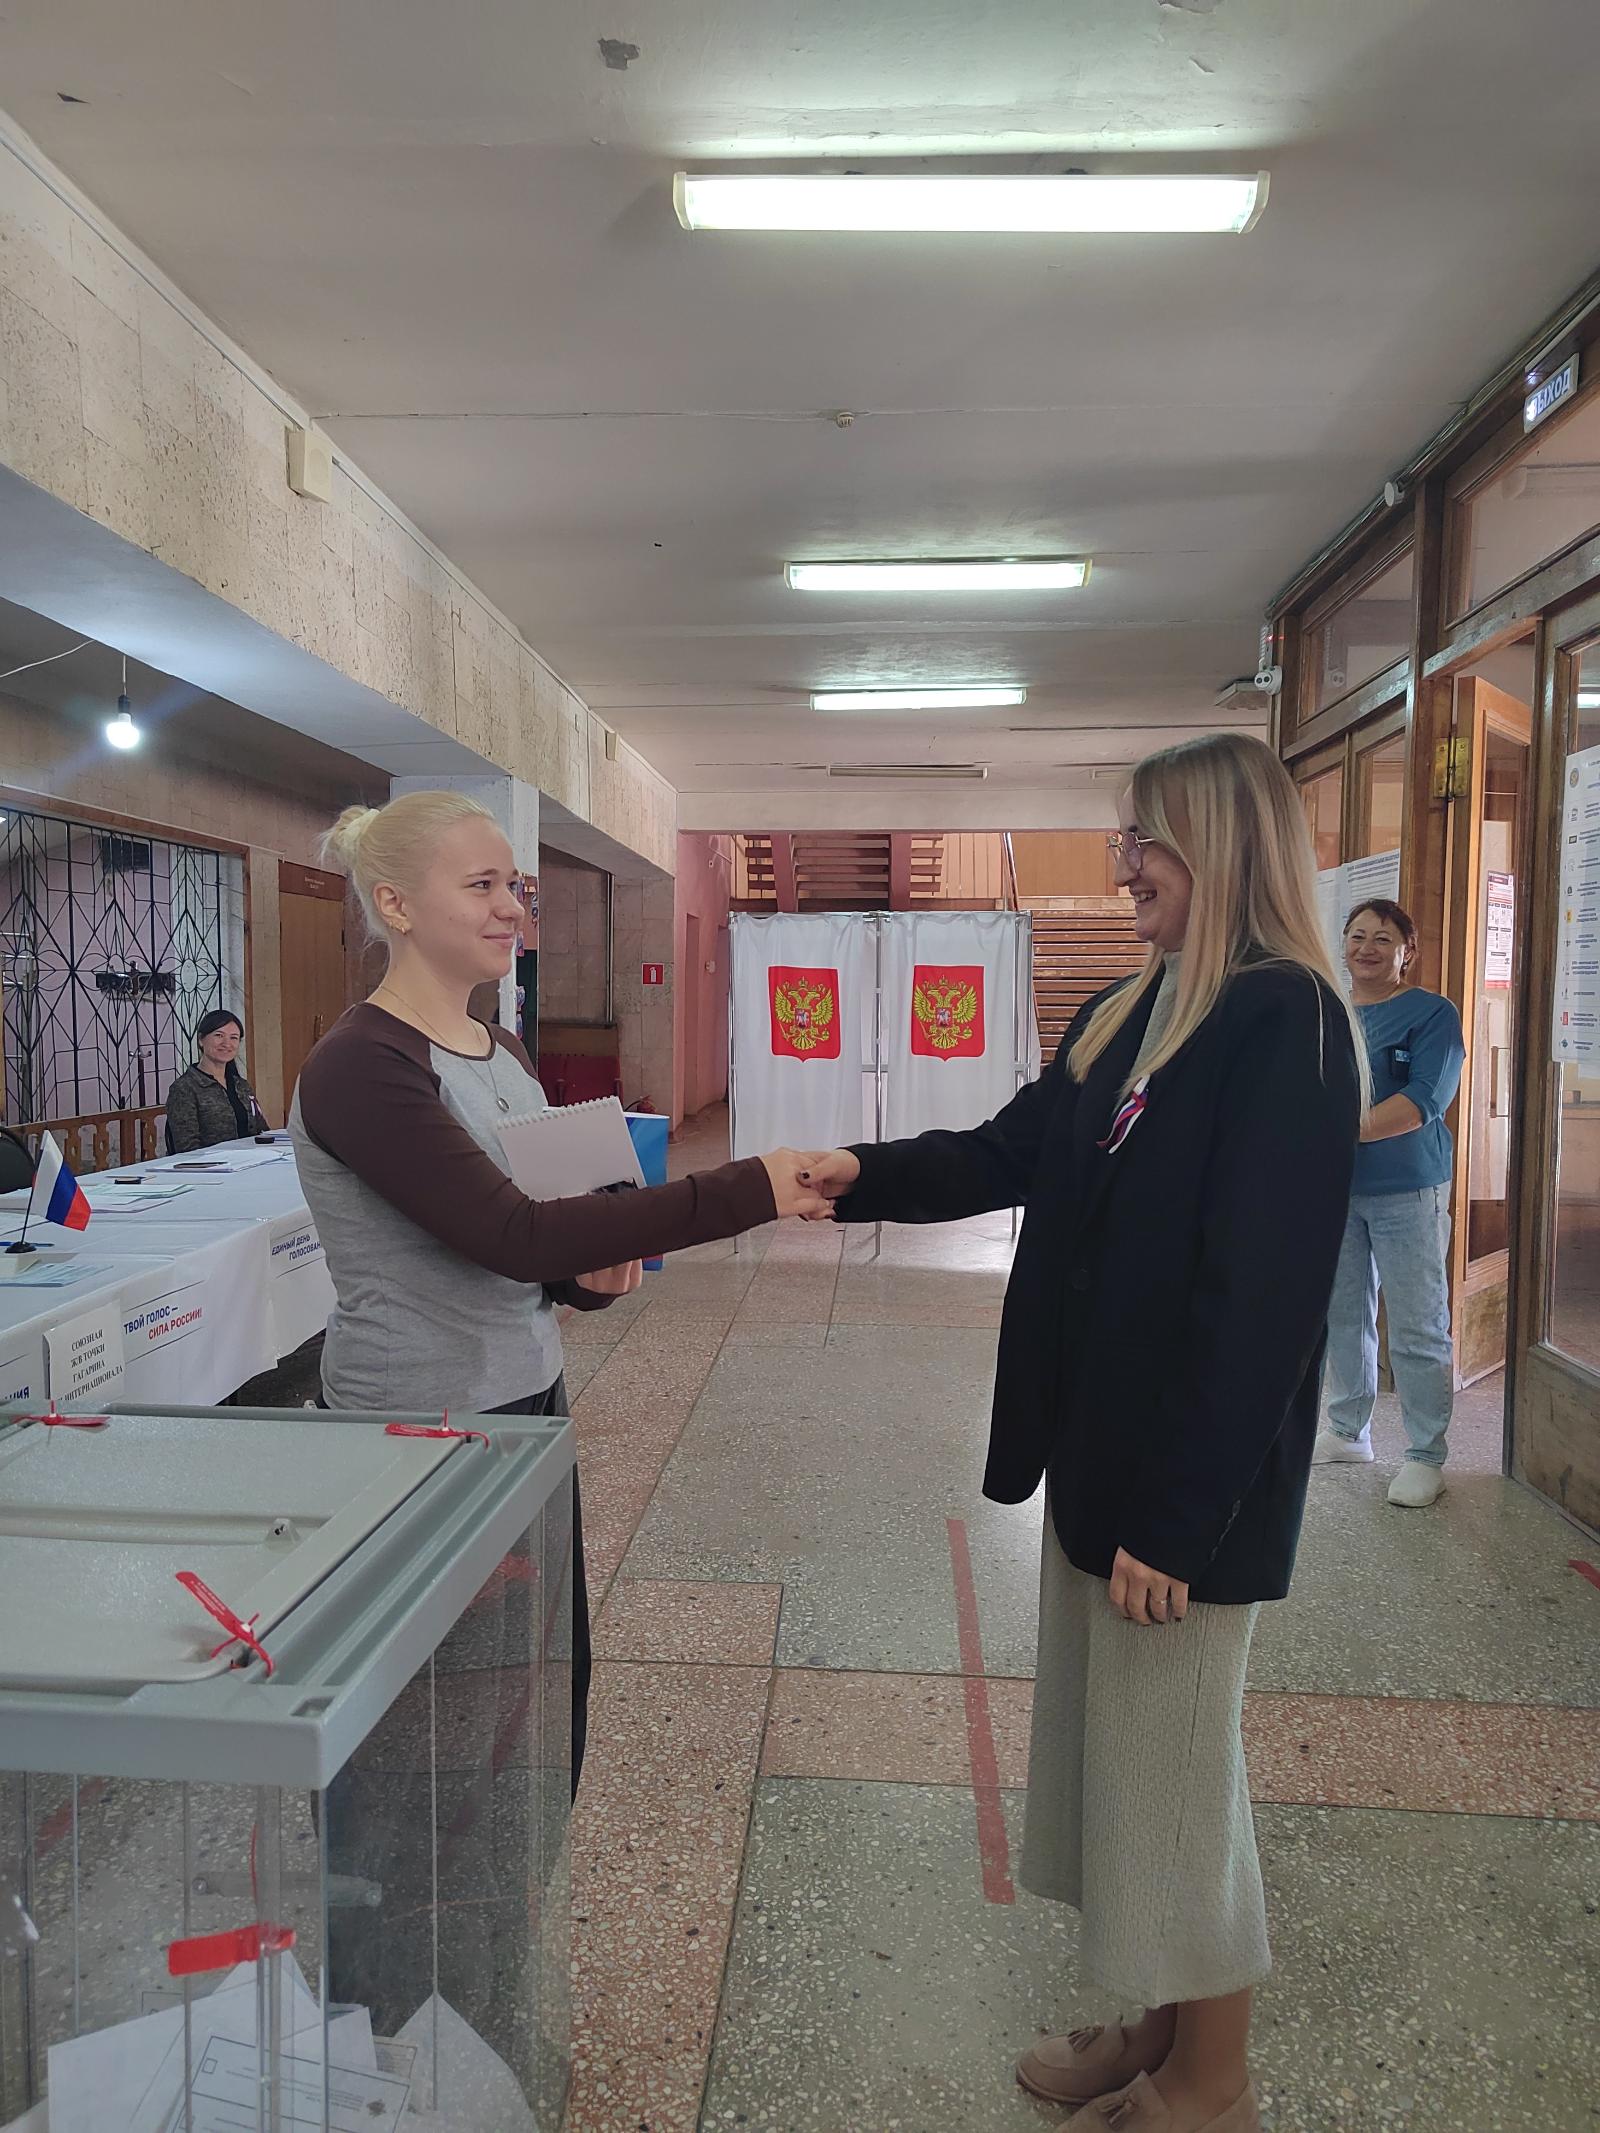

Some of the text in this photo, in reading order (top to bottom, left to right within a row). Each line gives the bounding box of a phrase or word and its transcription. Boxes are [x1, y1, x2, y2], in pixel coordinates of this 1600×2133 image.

[1528, 367, 1571, 420] ВЫХОД
[272, 1233, 311, 1255] ЕДИНЫЙ ДЕНЬ
[289, 1241, 321, 1261] ГОЛОСОВАН
[123, 1314, 145, 1335] ТВОЙ
[146, 1305, 171, 1325] ГОЛОС
[148, 1307, 203, 1340] СИЛА РОССИИ!
[71, 1328, 103, 1352] СОЮЗНАЯ
[83, 1343, 105, 1361] ТОЧКИ
[64, 1365, 123, 1401] ИНТЕРНАЦИОНАЛА
[72, 1359, 106, 1383] ГАГАРИНА
